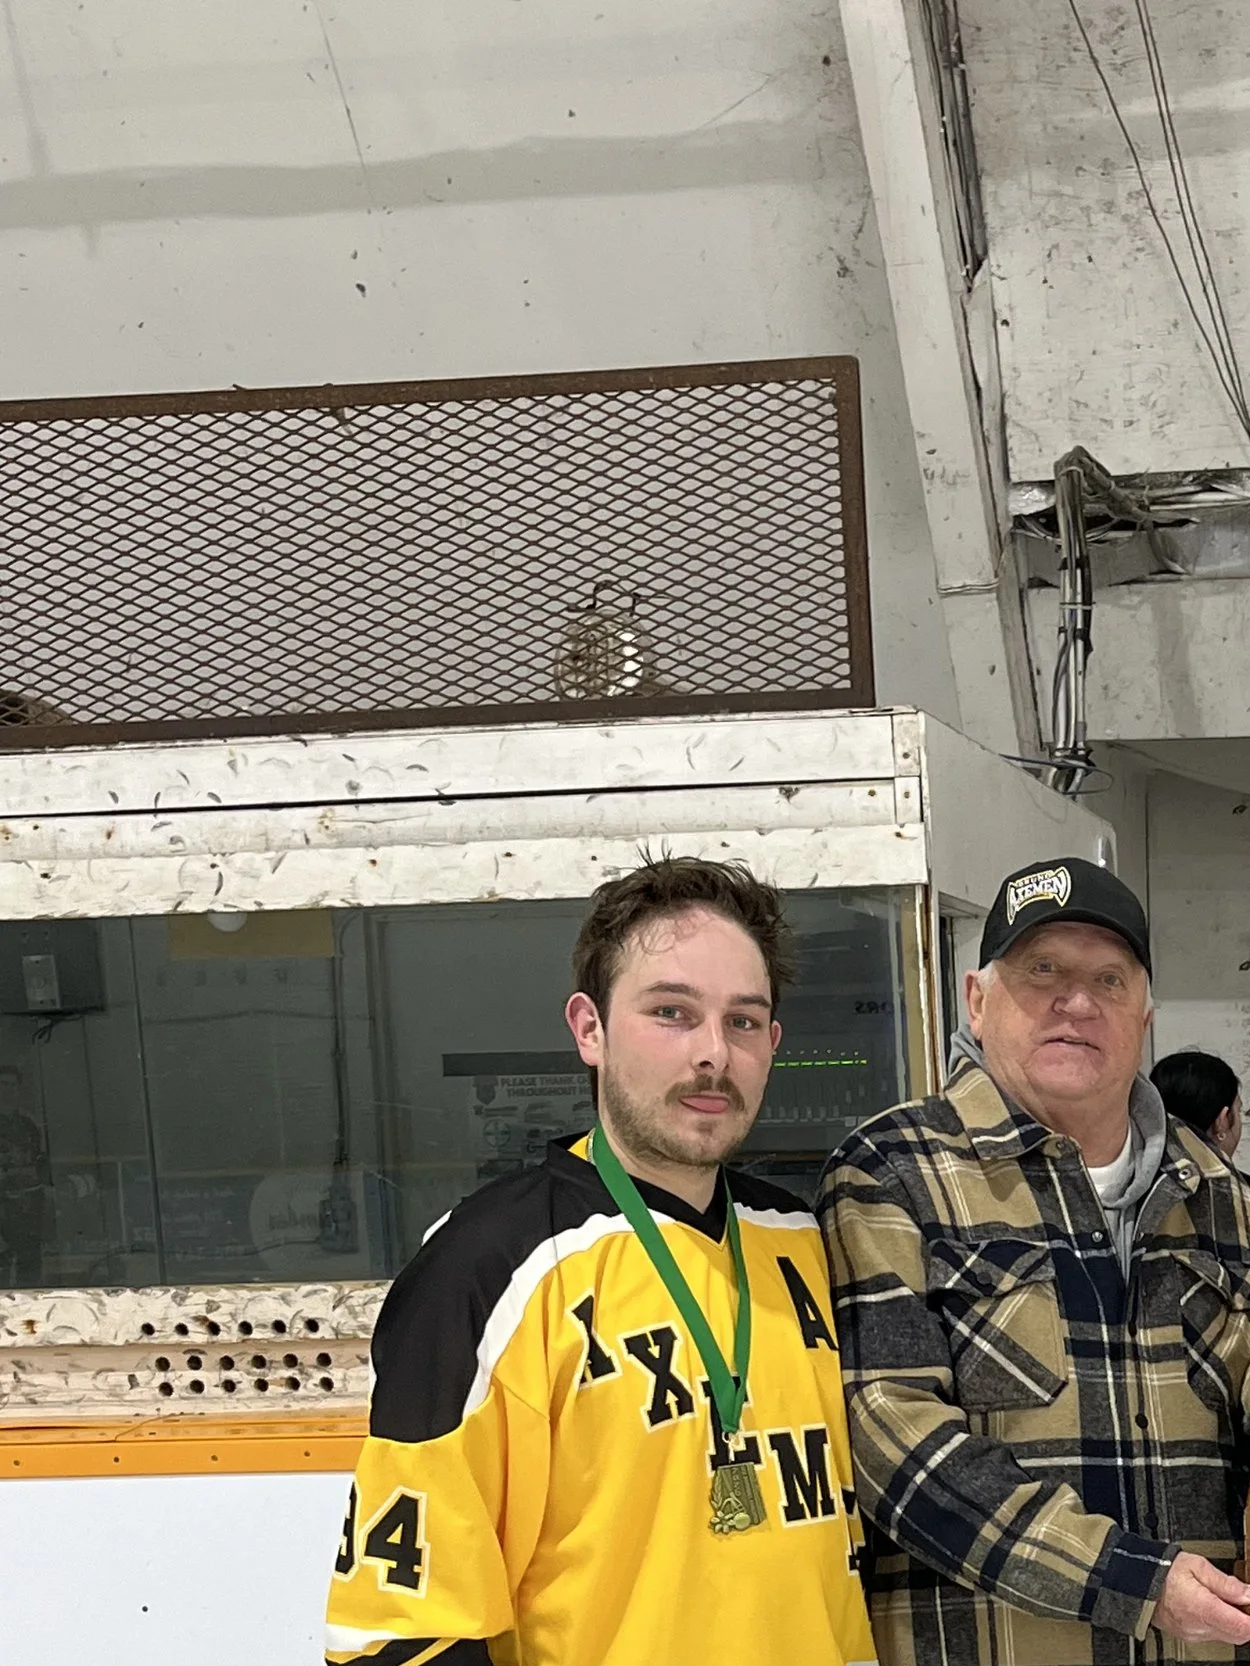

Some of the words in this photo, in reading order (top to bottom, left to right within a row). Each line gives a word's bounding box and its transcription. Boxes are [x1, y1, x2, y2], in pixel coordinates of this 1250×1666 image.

[1008, 868, 1067, 921] AXEMEN
[501, 1077, 537, 1087] PLEASE
[540, 1076, 574, 1085] THANK
[776, 1256, 839, 1350] A
